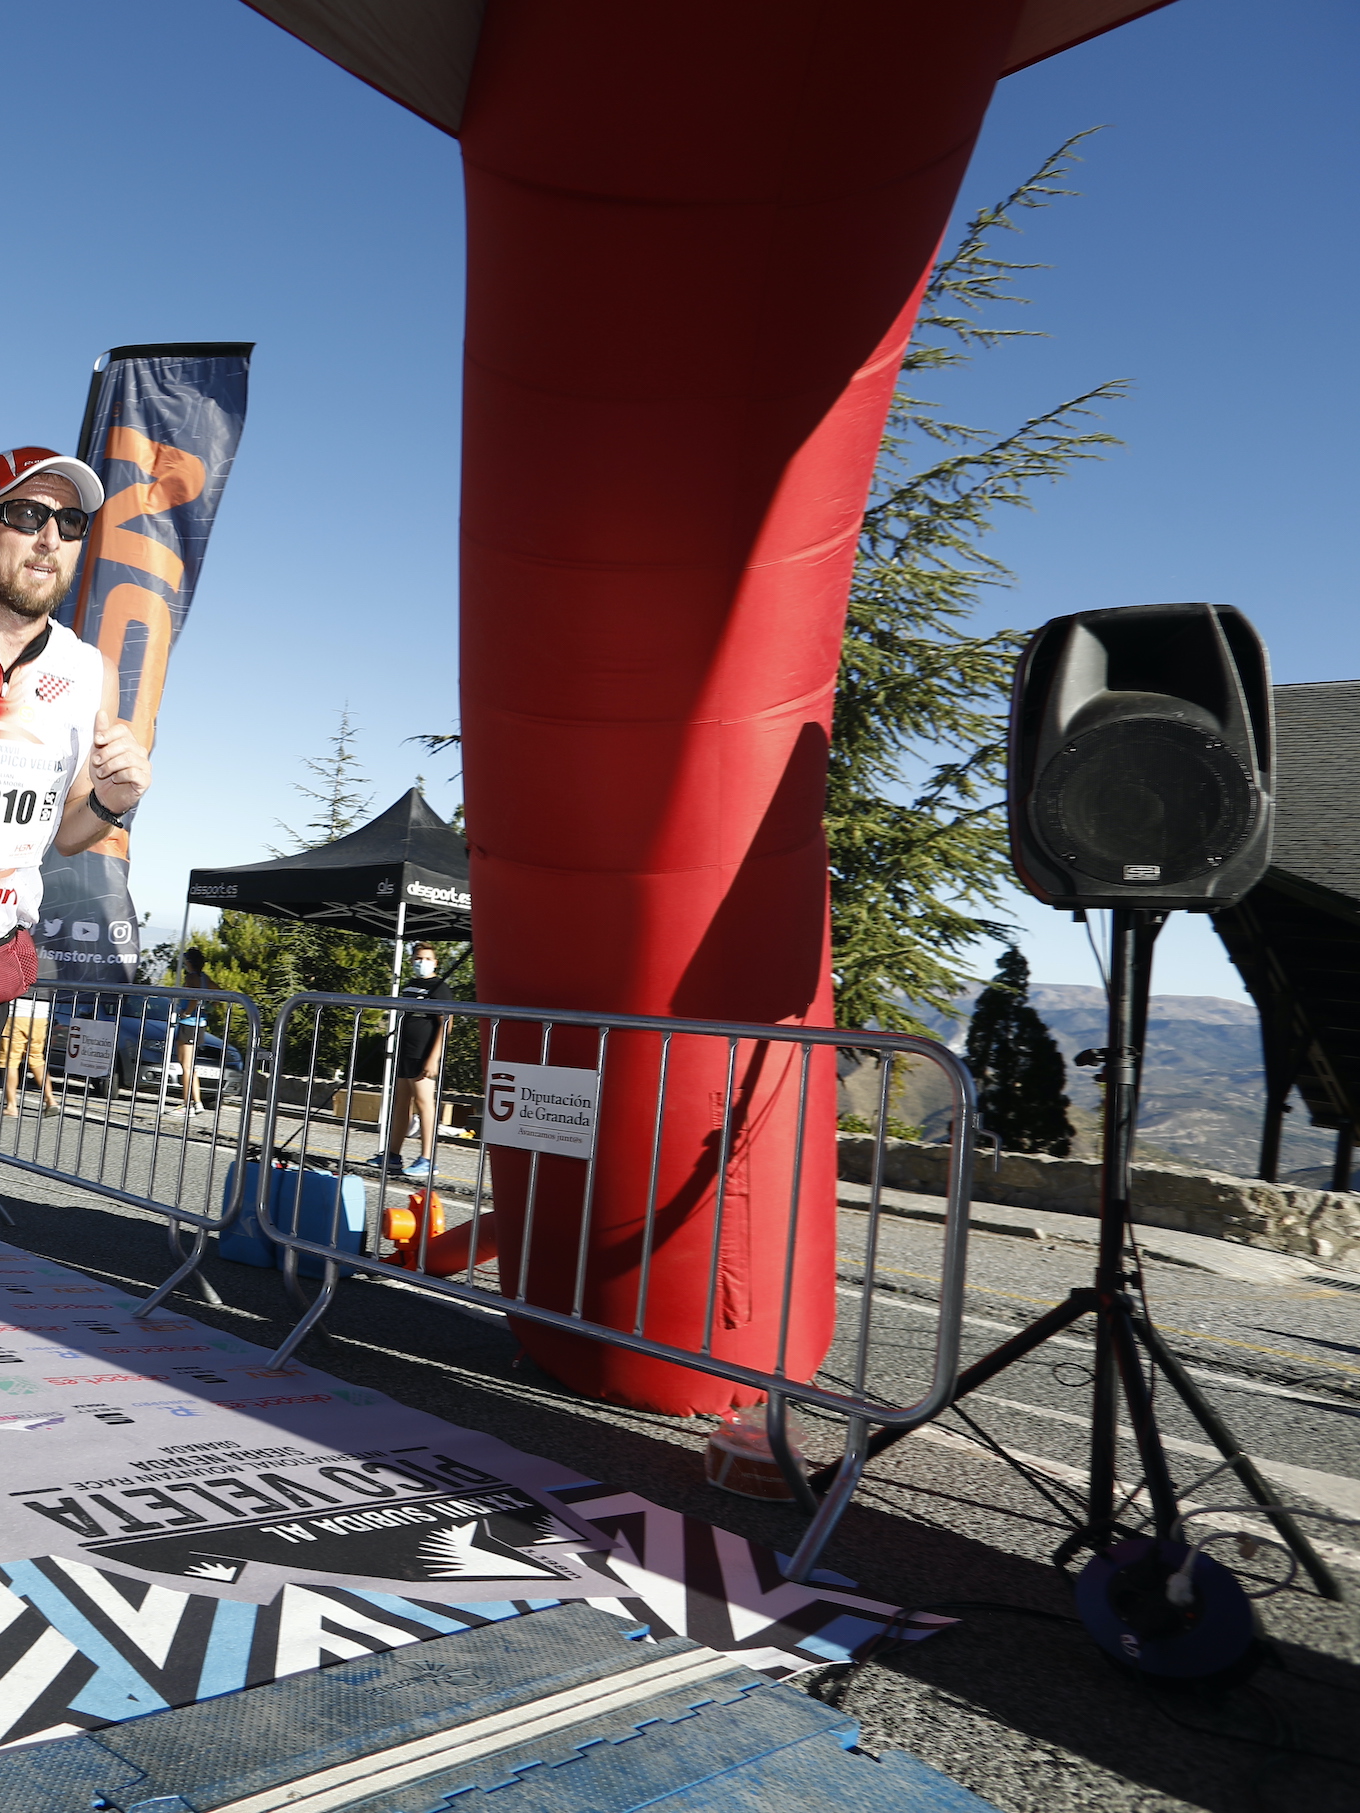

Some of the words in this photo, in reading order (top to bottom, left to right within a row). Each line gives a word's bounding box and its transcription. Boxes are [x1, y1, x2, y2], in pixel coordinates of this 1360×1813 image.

[0, 755, 27, 769] PICO
[520, 1087, 591, 1109] Diputación
[519, 1105, 534, 1119] de
[535, 1107, 590, 1127] Granada
[518, 1127, 555, 1140] Avanzamos
[157, 1440, 242, 1456] GRANADA
[222, 1446, 307, 1461] SIERRA
[127, 1453, 221, 1472] NEVADA
[249, 1449, 388, 1471] INTERNATIONAL
[68, 1476, 137, 1491] RACE
[135, 1462, 245, 1484] MOUNTAIN
[319, 1454, 503, 1497] PICO
[21, 1472, 343, 1538] VELETA
[425, 1492, 533, 1519] XXXVII
[310, 1506, 438, 1536] SUBIDA
[259, 1522, 318, 1544] AL
